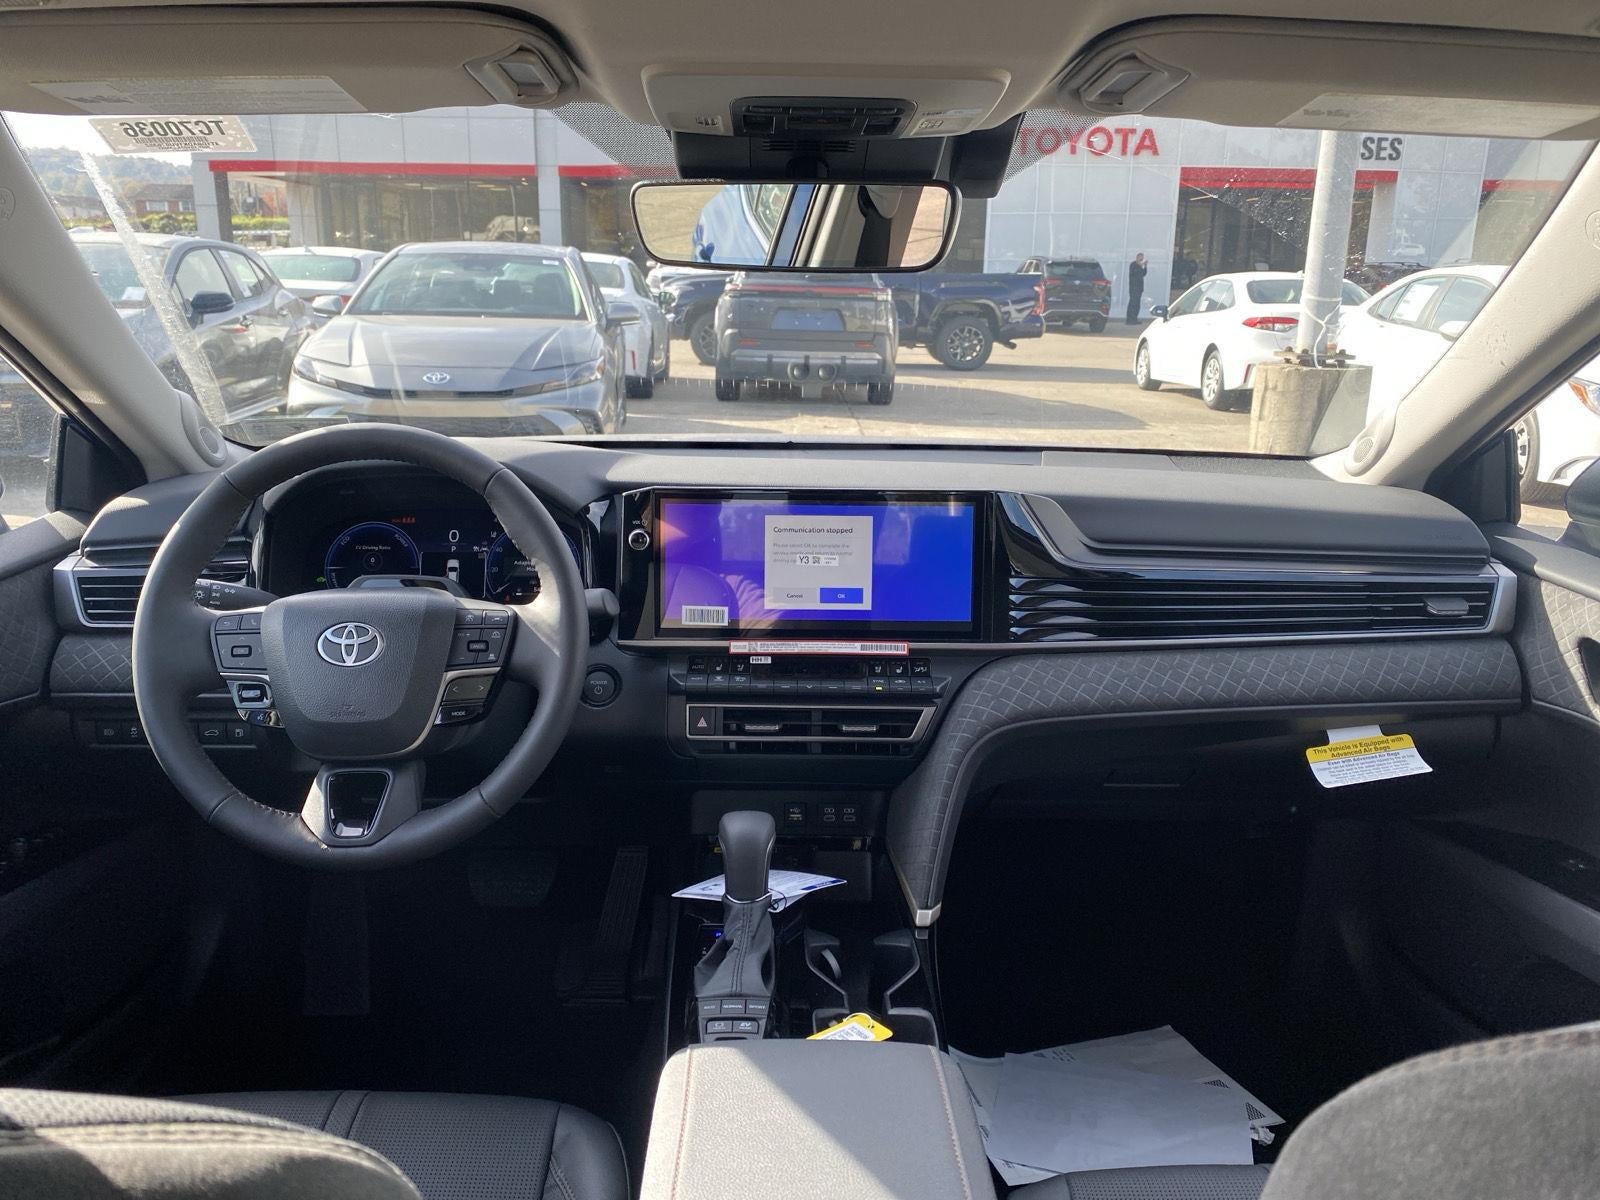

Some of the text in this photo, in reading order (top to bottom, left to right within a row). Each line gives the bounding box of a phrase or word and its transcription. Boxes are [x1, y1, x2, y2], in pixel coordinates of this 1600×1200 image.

[1019, 127, 1160, 157] TOYOTA
[1360, 136, 1402, 161] SES
[448, 529, 460, 543] 0
[773, 526, 854, 535] Communication stopped
[799, 555, 810, 565] Y3
[1328, 744, 1352, 753] Vehicle
[1360, 739, 1390, 749] Equipped
[1391, 736, 1404, 744] with
[1331, 750, 1362, 759] Advanced
[1374, 745, 1391, 754] Bags
